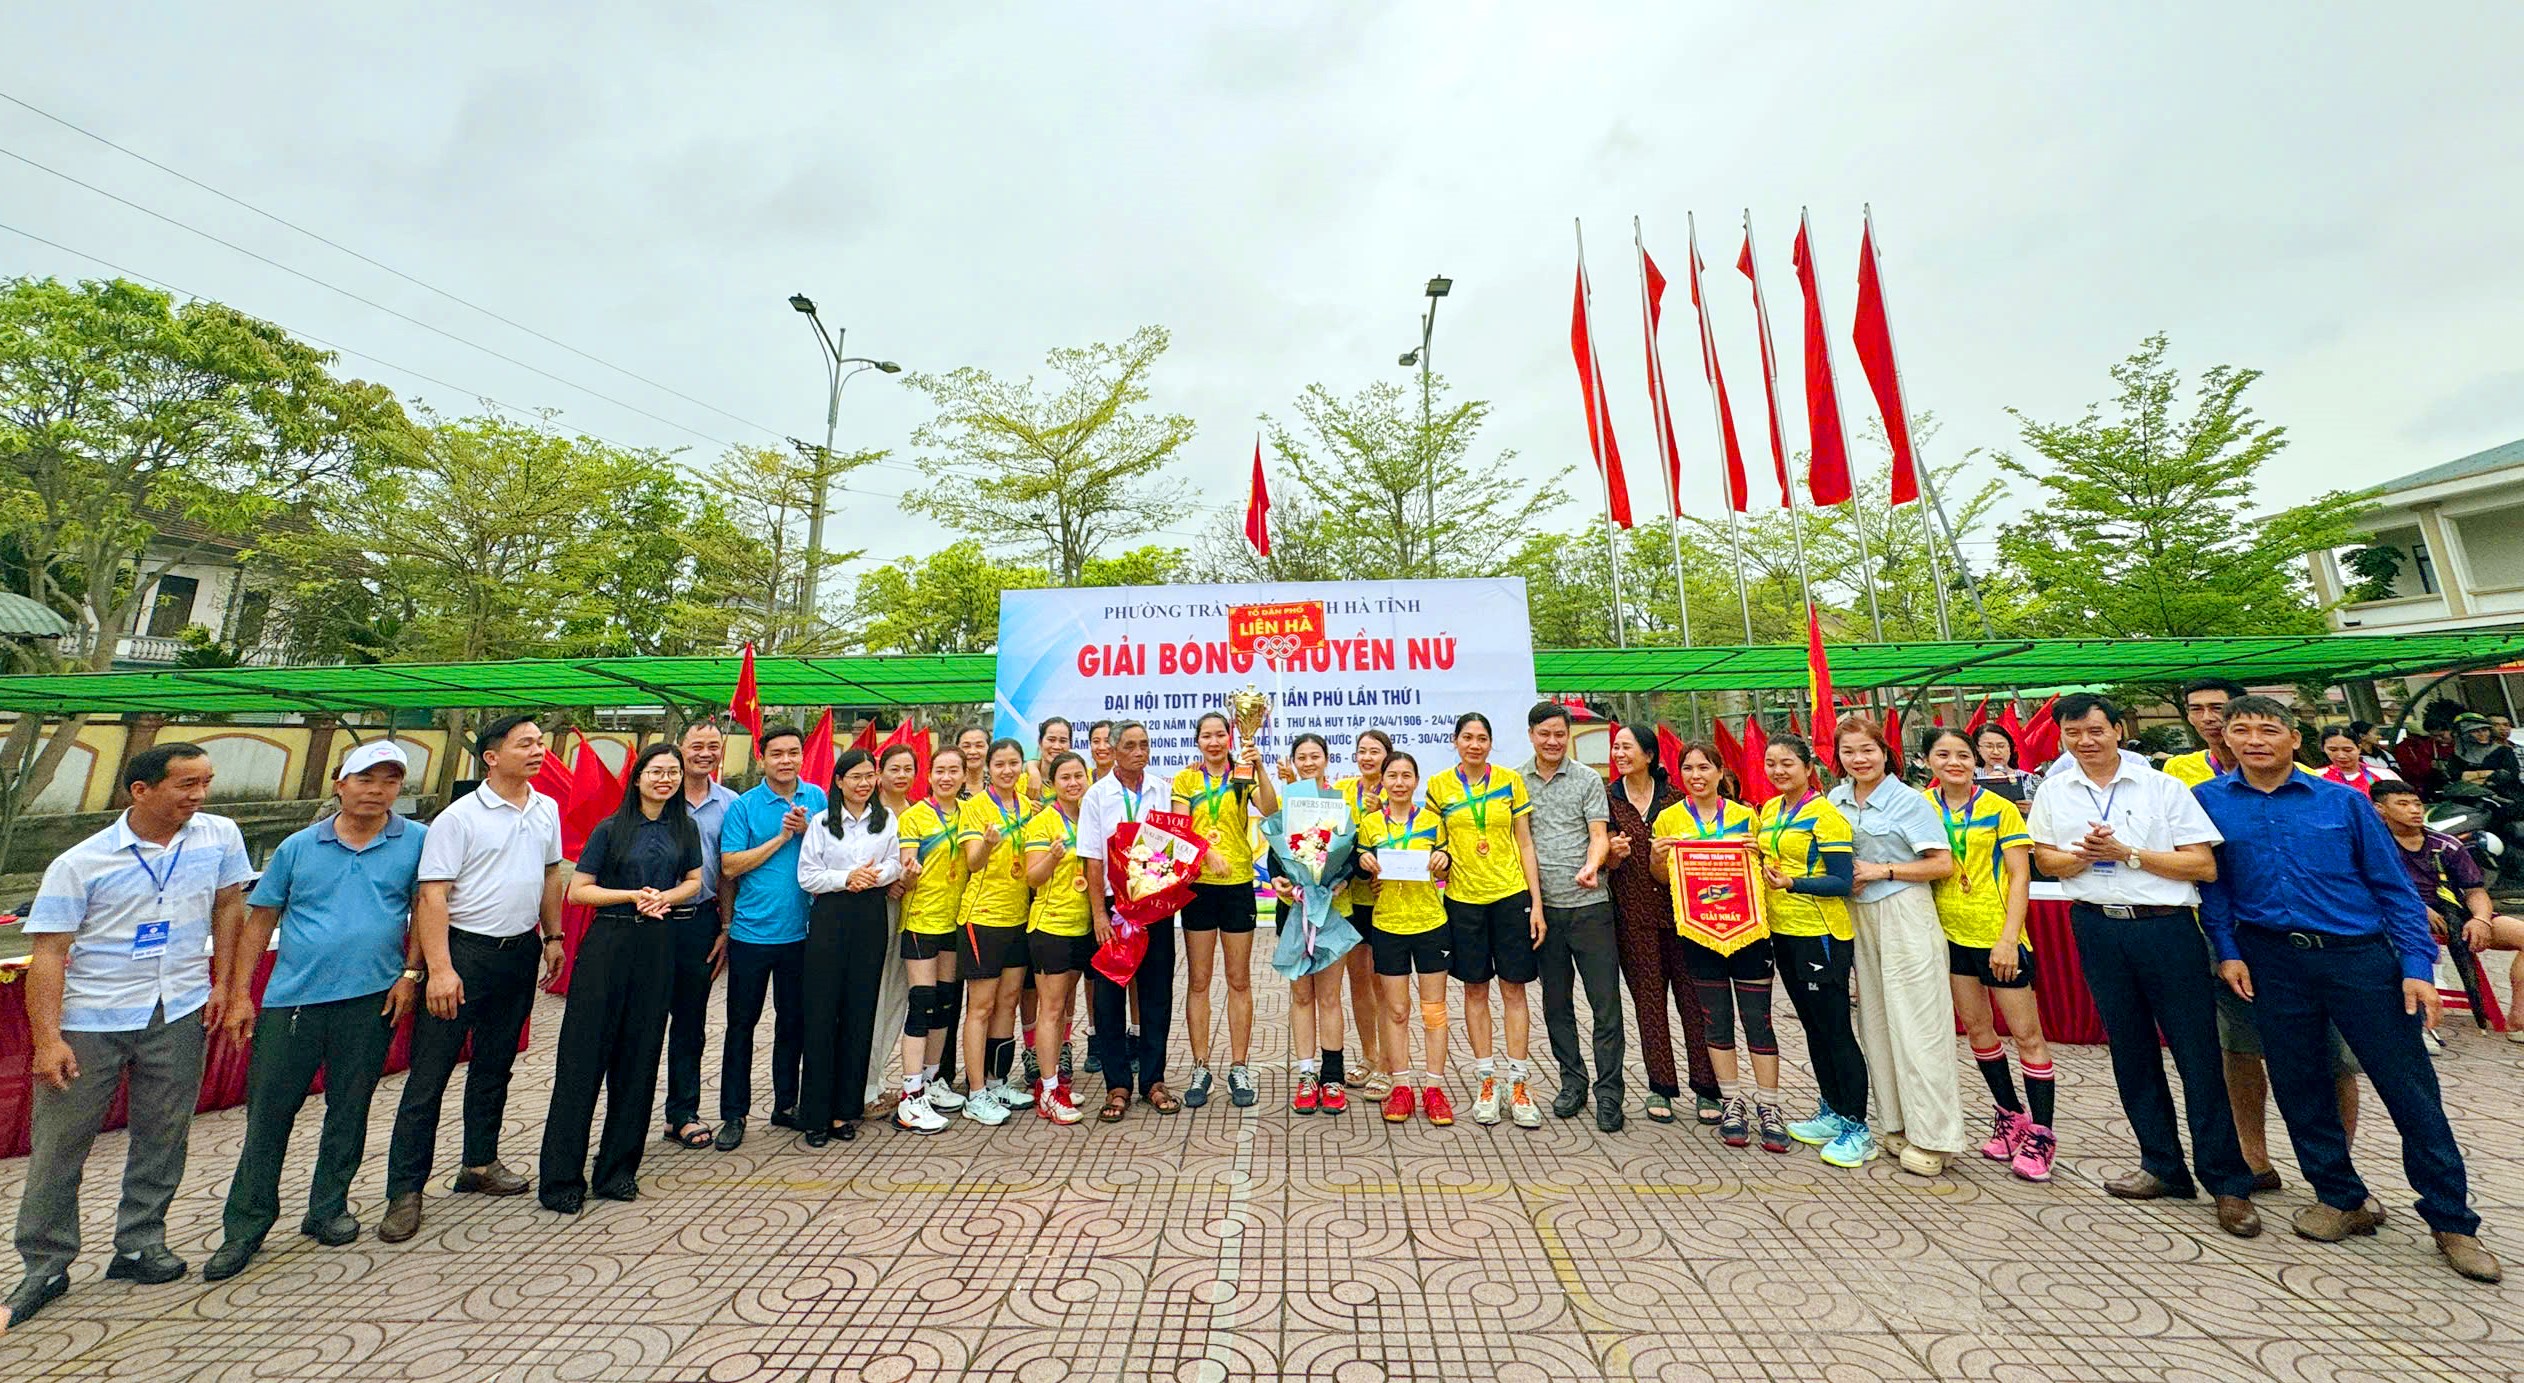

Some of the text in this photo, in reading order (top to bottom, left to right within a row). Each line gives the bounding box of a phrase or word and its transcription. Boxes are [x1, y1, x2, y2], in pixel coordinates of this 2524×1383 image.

[1104, 601, 1182, 620] PHƯỜNG
[1345, 596, 1371, 614] HÀ
[1375, 596, 1421, 613] TĨNH
[1240, 615, 1313, 636] LIÊN HÀ
[1077, 634, 1146, 677] GIẢI
[1266, 627, 1395, 674] HUYỀN
[1408, 630, 1457, 671] NỮ
[1105, 695, 1129, 714] ĐẠI
[1134, 690, 1159, 713] HỘI
[1164, 693, 1198, 709] TDTT
[1313, 687, 1343, 707] PHÚ
[1348, 684, 1377, 706] LẦN
[1382, 686, 1412, 705] THỨ
[1416, 689, 1421, 705] I
[1163, 717, 1186, 730] NĂM
[1287, 716, 1306, 728] THƯ
[1308, 714, 1322, 728] HÀ
[1324, 716, 1344, 728] HUY
[1347, 714, 1366, 730] TẬP
[1148, 735, 1177, 748] HÓNG
[1163, 752, 1190, 766] NGÀY
[1167, 815, 1189, 828] YOU
